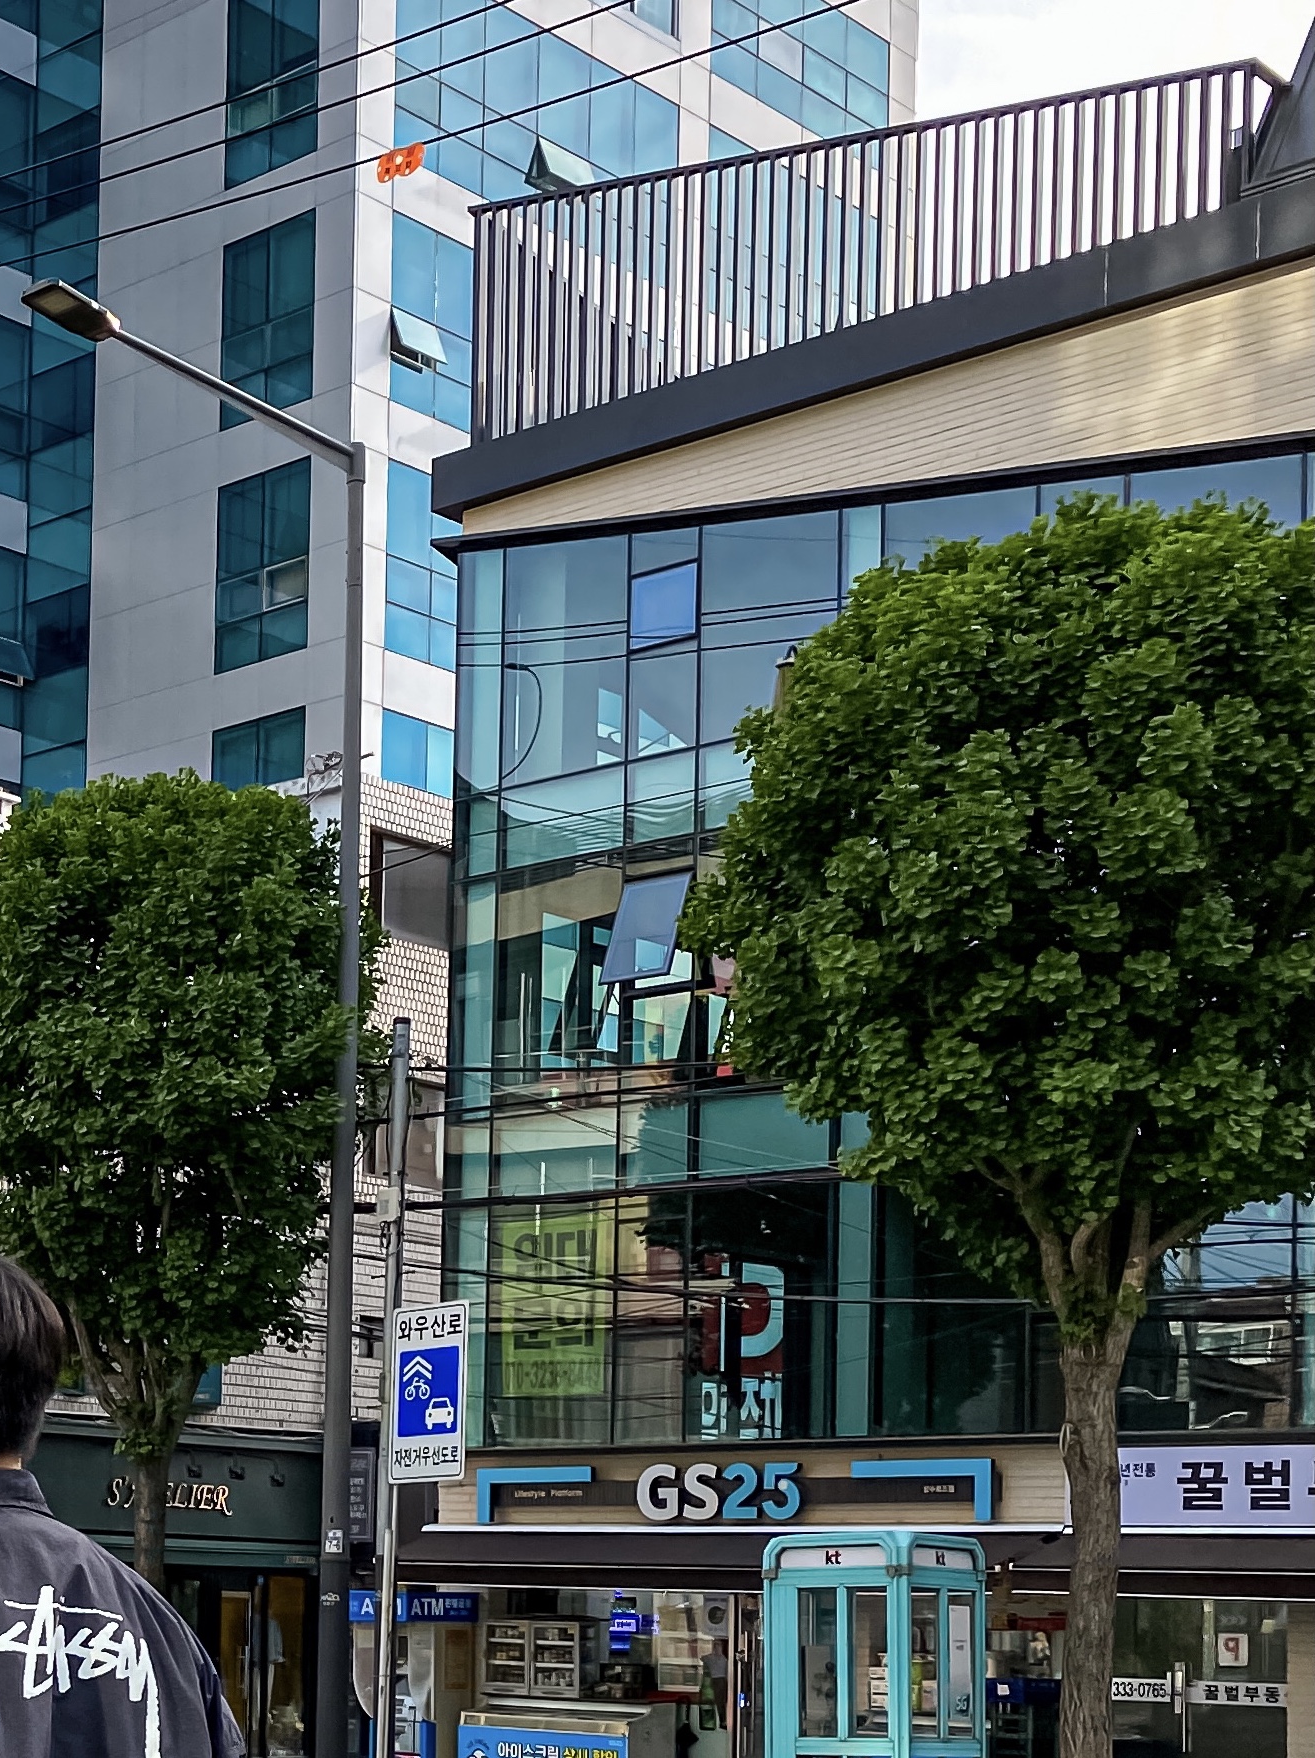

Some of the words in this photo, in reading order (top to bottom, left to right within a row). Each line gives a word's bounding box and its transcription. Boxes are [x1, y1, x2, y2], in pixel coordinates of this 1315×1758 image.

[398, 1313, 462, 1342] 와우산로
[394, 1446, 459, 1468] 자전거우선도로
[636, 1462, 801, 1521] GS25
[825, 1551, 841, 1565] kt
[935, 1551, 946, 1566] kt
[410, 1598, 444, 1616] ATM
[1113, 1681, 1167, 1698] 333-0765
